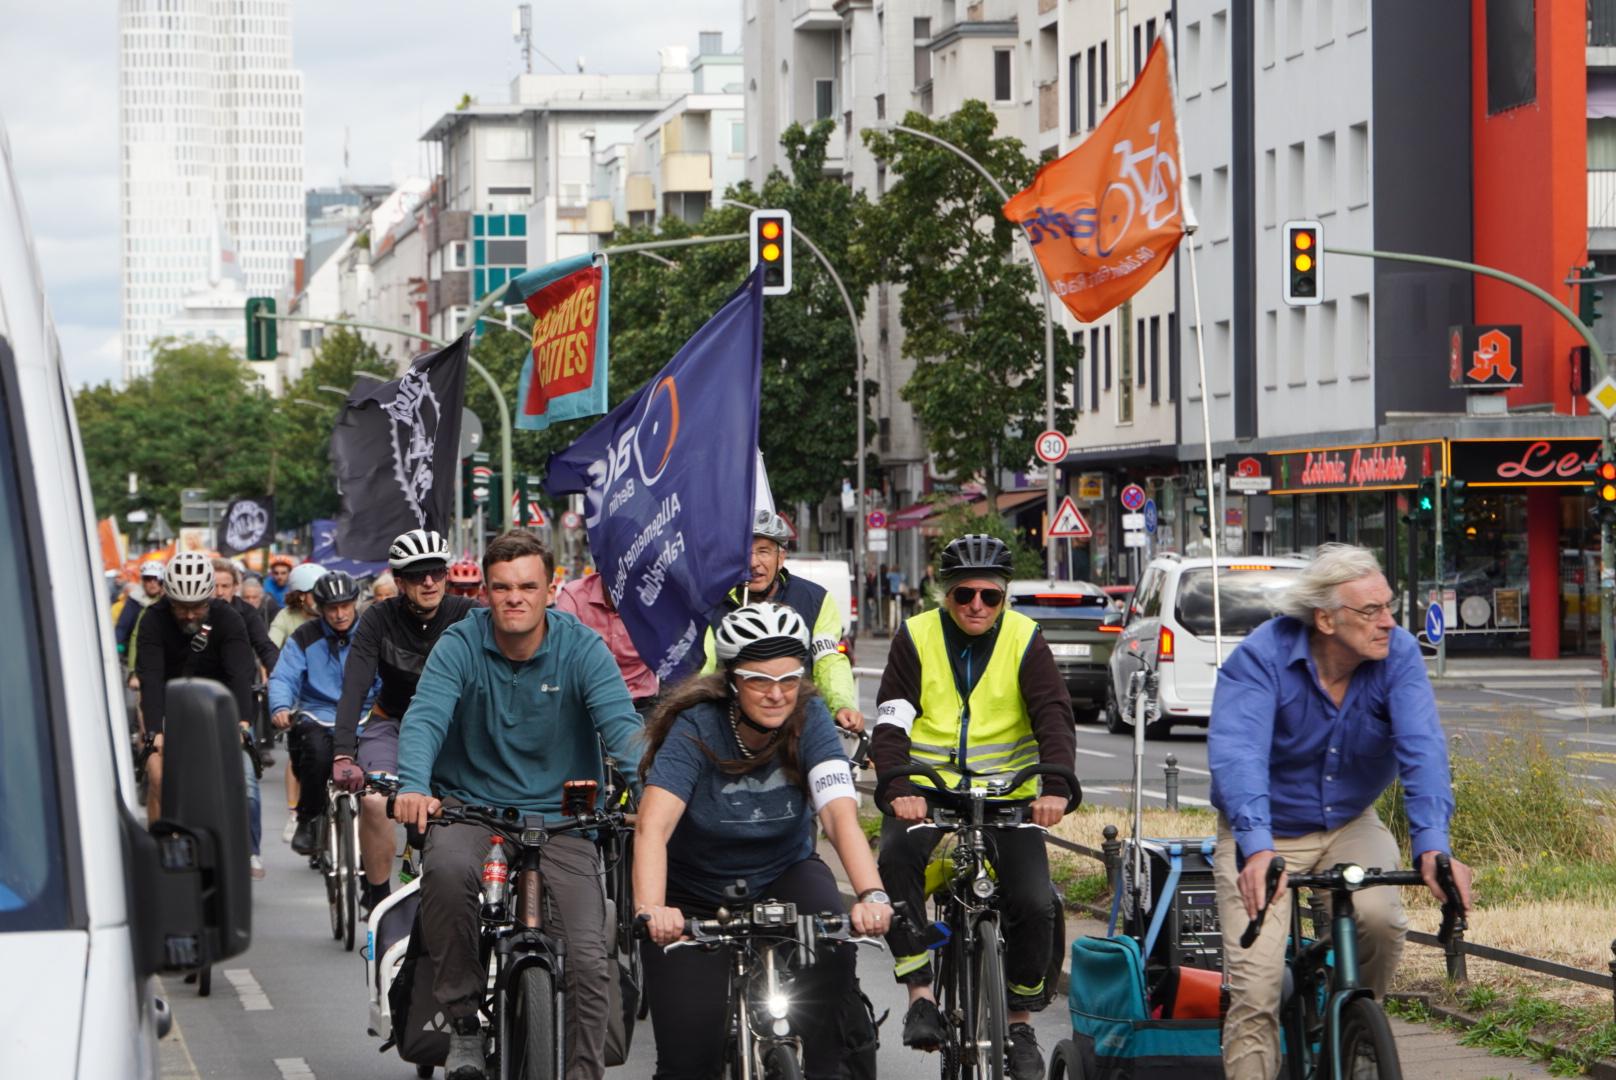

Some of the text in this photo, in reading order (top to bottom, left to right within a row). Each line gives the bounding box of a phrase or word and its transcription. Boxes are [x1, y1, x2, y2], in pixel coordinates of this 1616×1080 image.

[538, 331, 588, 388] CITIES
[1043, 439, 1062, 454] 30
[1349, 446, 1407, 487] Apotheke
